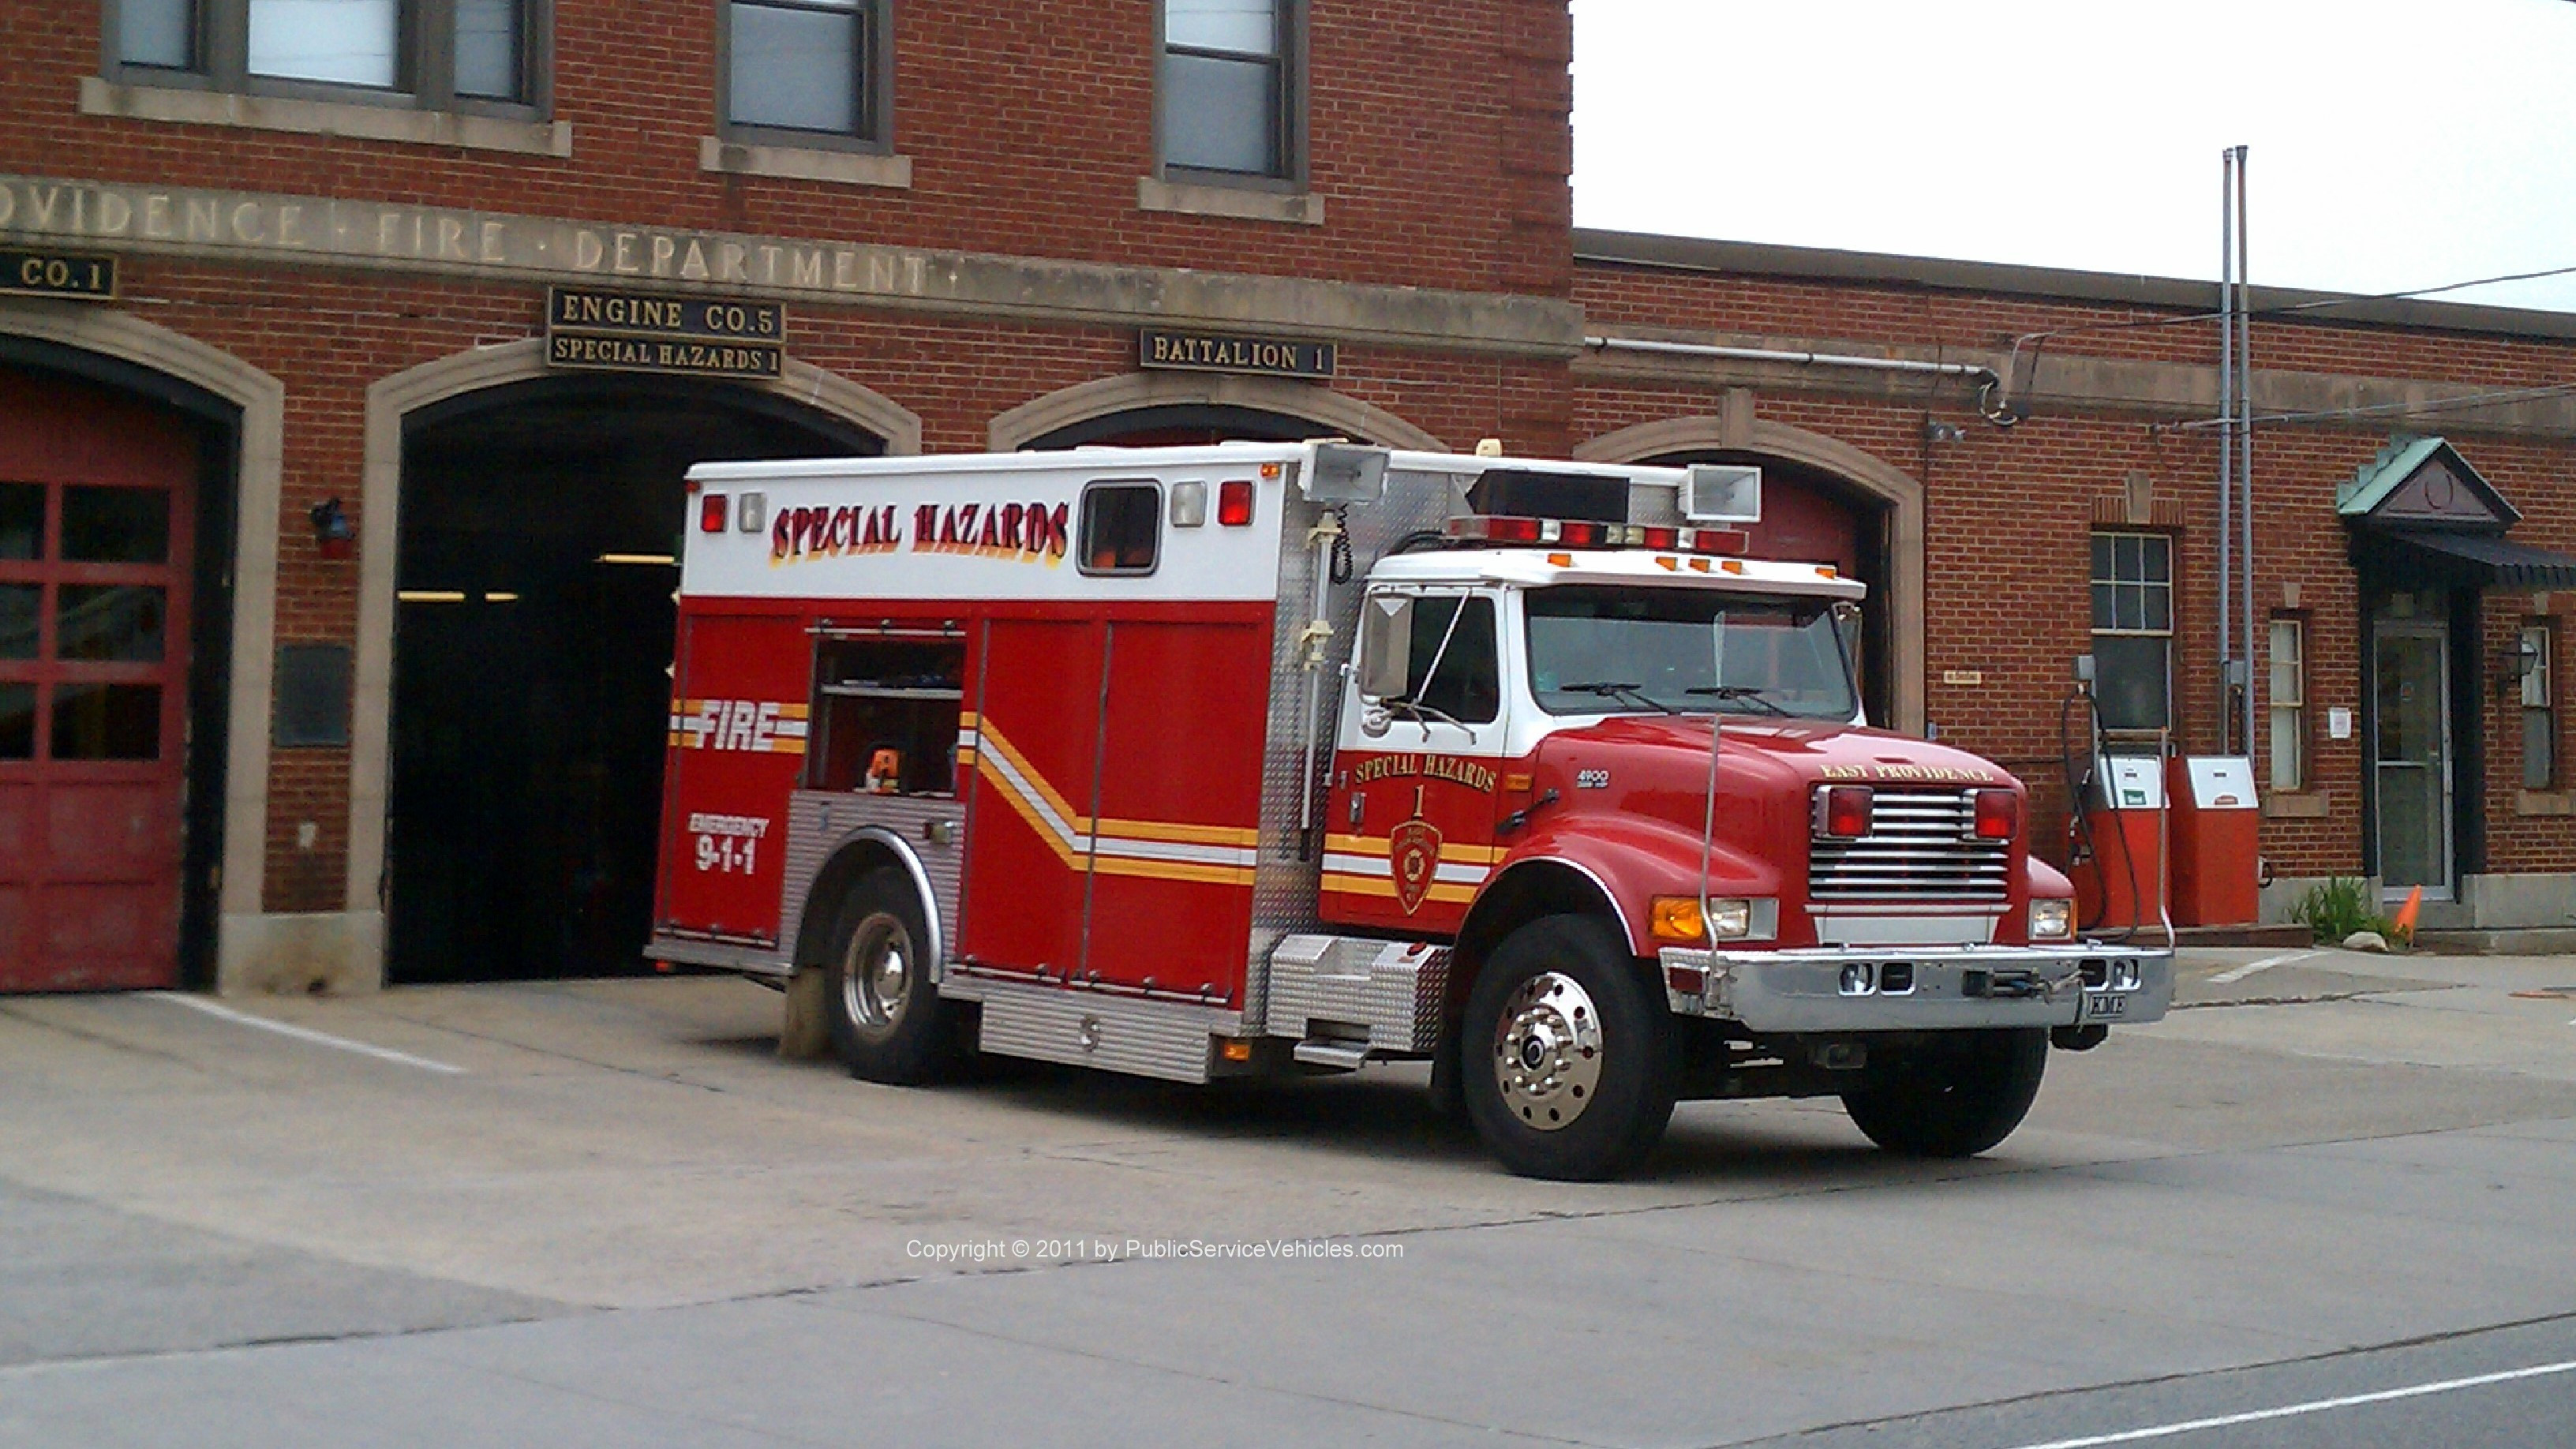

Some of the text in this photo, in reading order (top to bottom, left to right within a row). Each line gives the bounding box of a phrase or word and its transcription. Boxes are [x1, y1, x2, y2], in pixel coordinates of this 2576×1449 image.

[377, 212, 507, 262] FIRE
[576, 230, 927, 294] DEPARTMENT
[563, 294, 773, 334] ENGINE CO.5
[555, 338, 779, 371] SPECIAL HAZARDS 1
[1153, 336, 1324, 369] BATTALION 1
[769, 500, 1069, 570] SPECIAL HAZARDS
[695, 699, 780, 752] FIRE
[1355, 754, 1497, 793] SPECIAL HAZARDS
[1820, 764, 1994, 782] EAST PROVIDENCE
[1413, 784, 1425, 818] 1
[688, 812, 770, 838] EMERGENCY
[695, 834, 756, 875] 9-1-1
